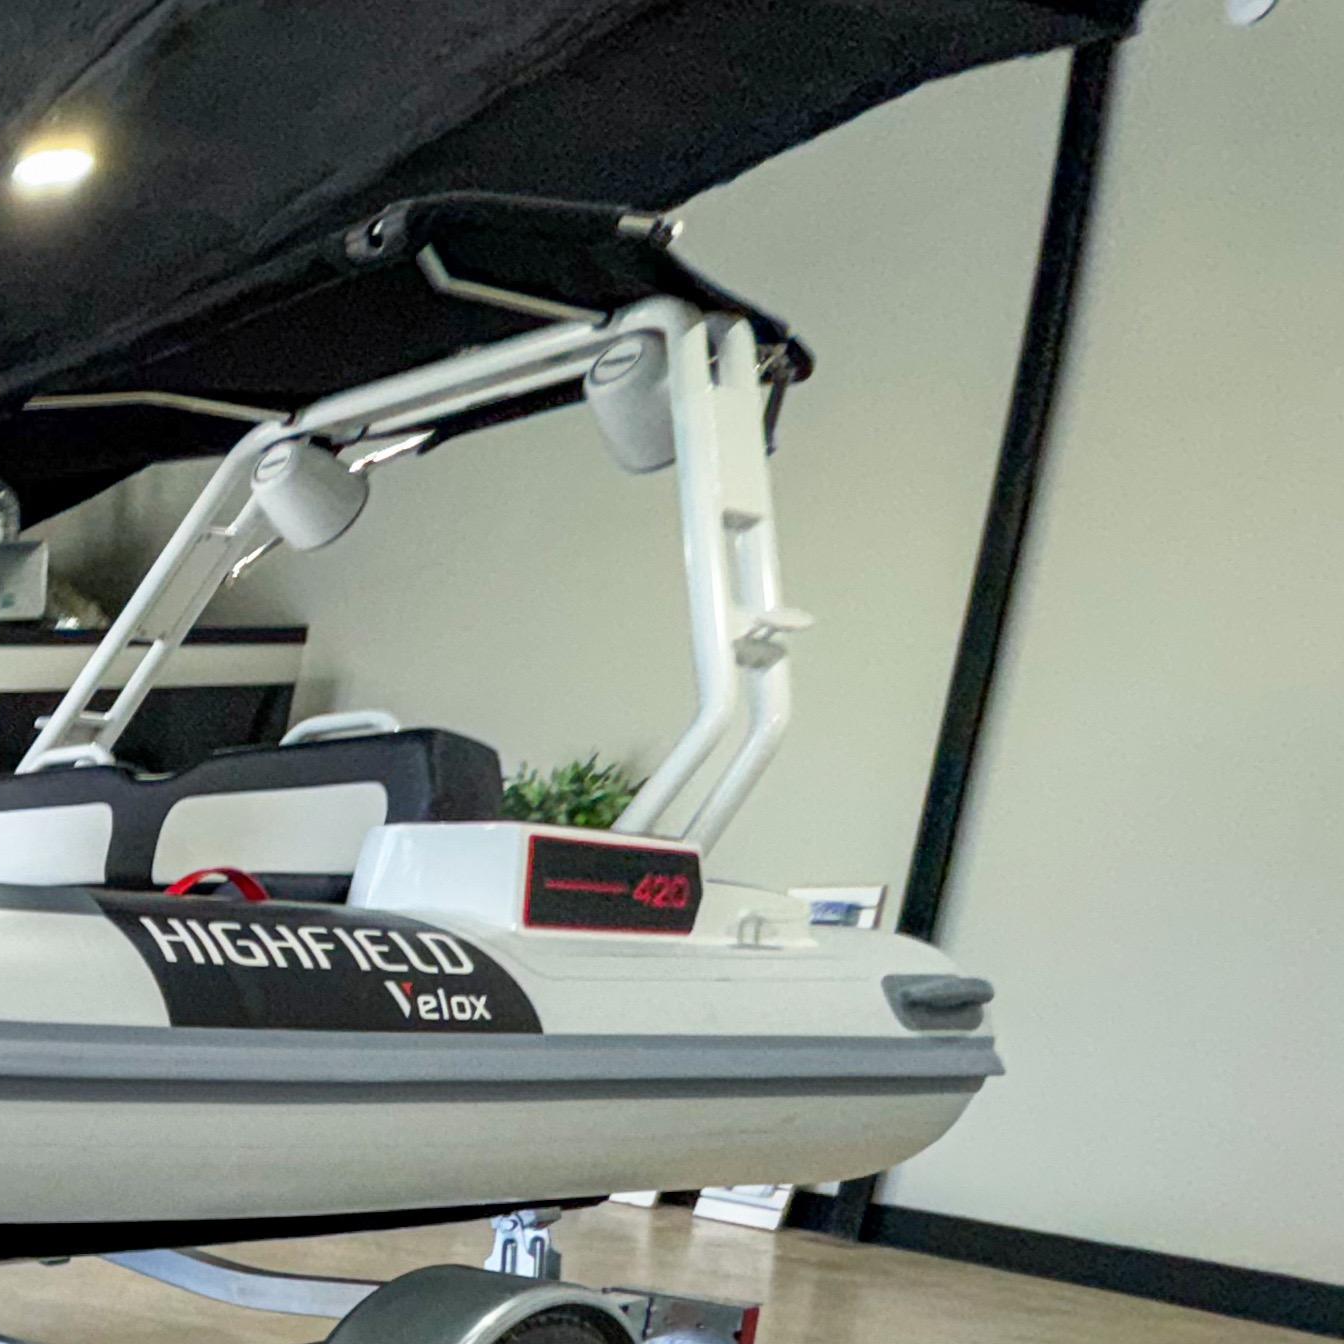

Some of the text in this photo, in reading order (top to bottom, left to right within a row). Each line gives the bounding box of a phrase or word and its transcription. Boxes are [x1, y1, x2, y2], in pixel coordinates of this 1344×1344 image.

[632, 873, 691, 909] 420
[138, 915, 475, 976] HIGHFIELD
[383, 979, 493, 1021] Velox
